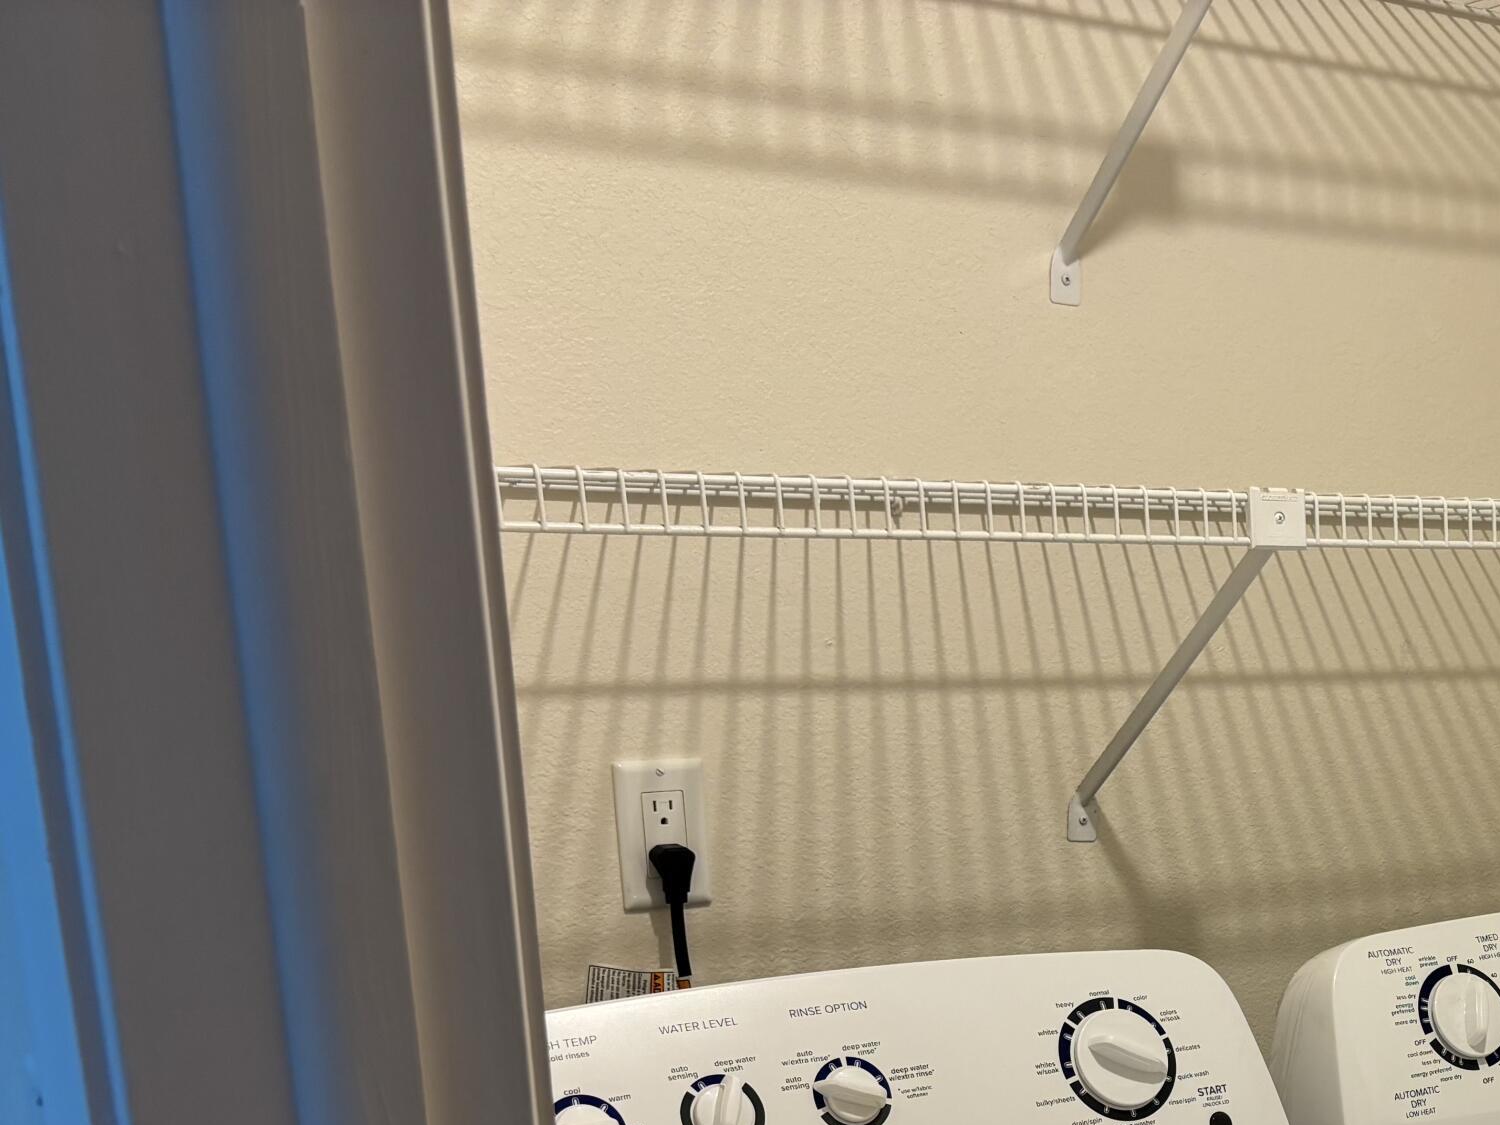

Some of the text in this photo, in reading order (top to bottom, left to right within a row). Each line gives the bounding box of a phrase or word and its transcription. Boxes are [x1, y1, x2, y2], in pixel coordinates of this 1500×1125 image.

[1475, 933, 1498, 943] TIMED
[1482, 943, 1498, 952] DRY
[1368, 946, 1414, 959] AUTOMATIC
[1386, 958, 1401, 966] DRY
[789, 1000, 868, 1018] RINSE OPTION
[658, 1017, 738, 1034] WATER LEVEL
[563, 1035, 597, 1048] TEMP
[842, 1043, 860, 1051] deep
[1175, 1044, 1200, 1052] delicates
[550, 1051, 590, 1062] old rinses
[796, 1050, 813, 1058] auto
[714, 1059, 734, 1067] deep
[781, 1058, 808, 1066] w/extra
[723, 1065, 743, 1073] wash
[1429, 1066, 1452, 1076] preferred
[668, 1071, 699, 1080] sensing
[785, 1076, 802, 1084] auto
[889, 1073, 915, 1081] w/extra
[781, 1082, 810, 1091] sensing
[1197, 1084, 1227, 1097] START
[564, 1088, 581, 1096] cool
[1394, 1085, 1440, 1100] AUTOMATIC
[608, 1094, 631, 1102] warm
[1036, 1096, 1076, 1107] bulky/sheets
[1169, 1097, 1196, 1105] rinse/spin
[1411, 1099, 1426, 1108] DRY
[1421, 1107, 1436, 1116] HEAT
